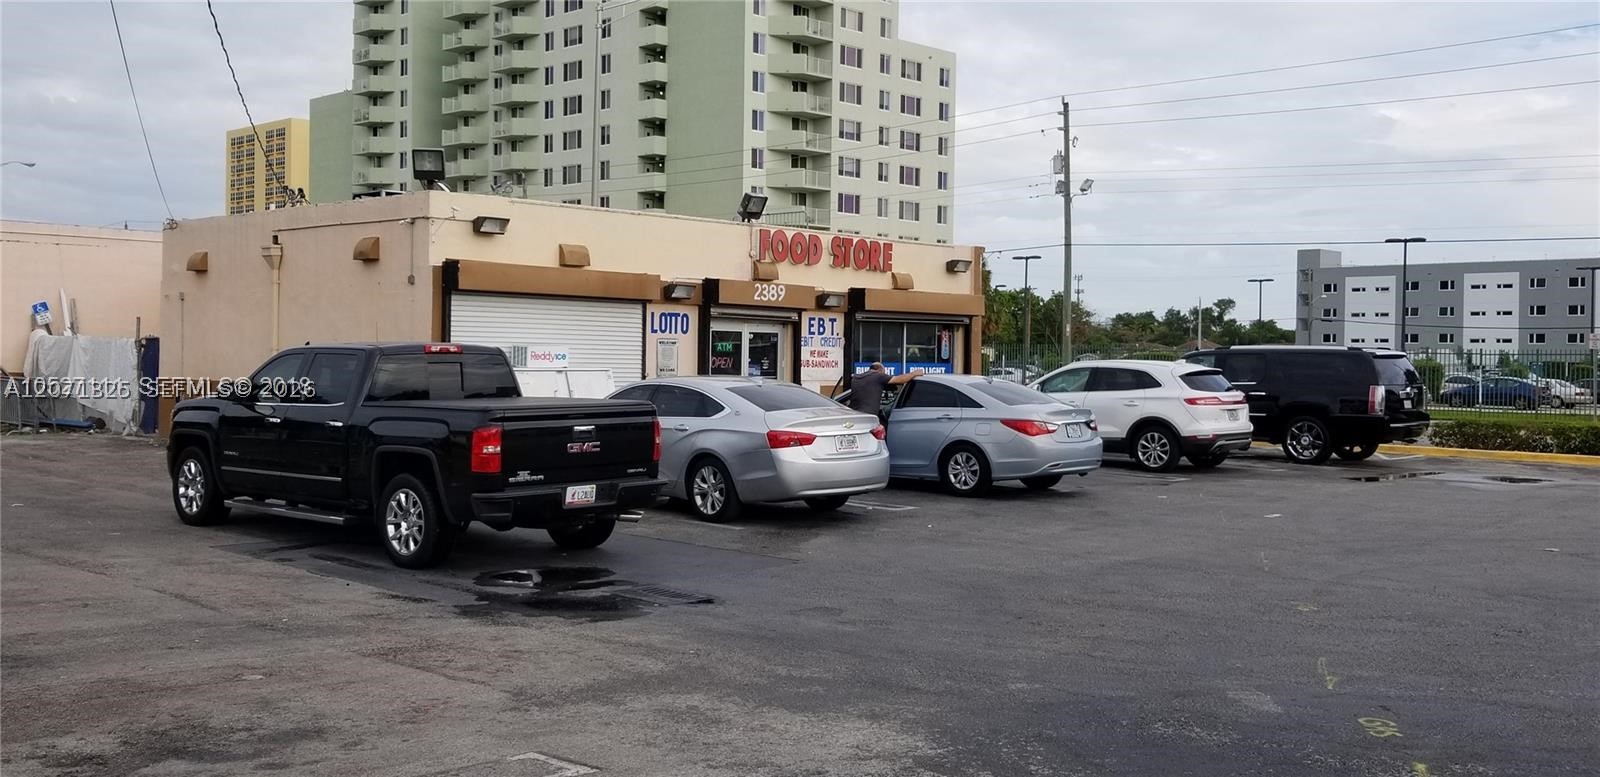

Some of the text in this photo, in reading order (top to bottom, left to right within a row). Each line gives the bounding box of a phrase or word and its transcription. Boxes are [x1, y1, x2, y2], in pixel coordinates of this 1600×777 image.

[758, 228, 893, 273] FOOD STORE
[753, 283, 786, 302] 2389
[650, 312, 690, 335] LOTTO
[717, 342, 733, 352] ATM
[820, 336, 843, 348] CREDIT
[810, 350, 817, 358] WE
[711, 356, 734, 369] OPEN
[924, 366, 946, 375] LIGHT
[567, 441, 600, 453] GMC
